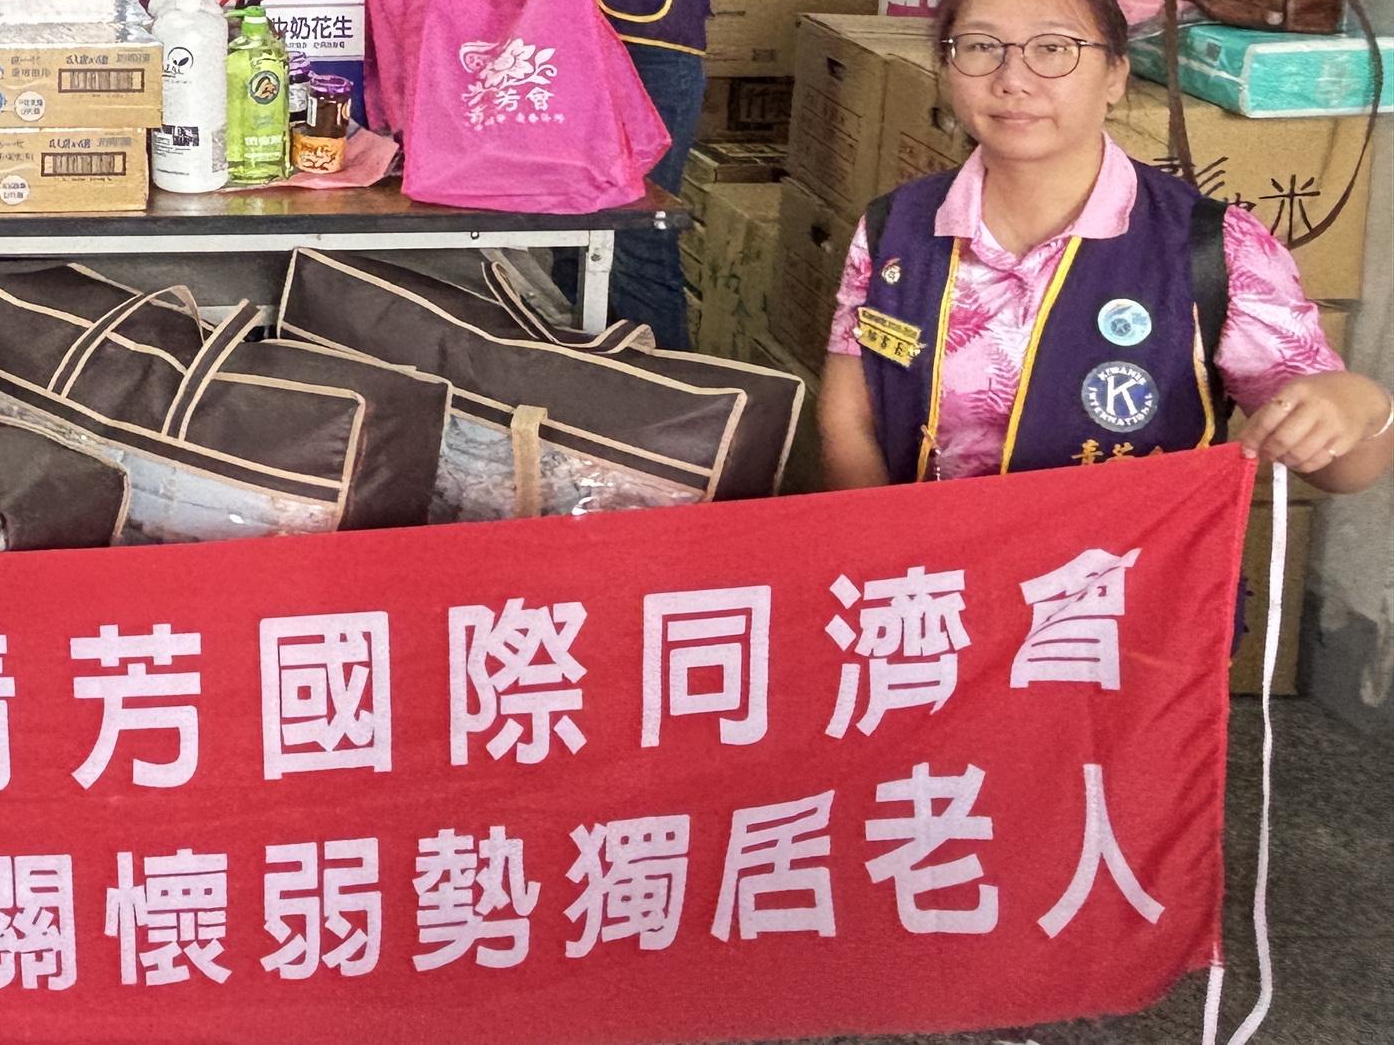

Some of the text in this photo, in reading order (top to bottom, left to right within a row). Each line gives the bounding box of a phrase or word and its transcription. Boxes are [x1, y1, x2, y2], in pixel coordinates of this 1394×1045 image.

[271, 14, 354, 40] 牛奶花生
[1105, 374, 1139, 417] K
